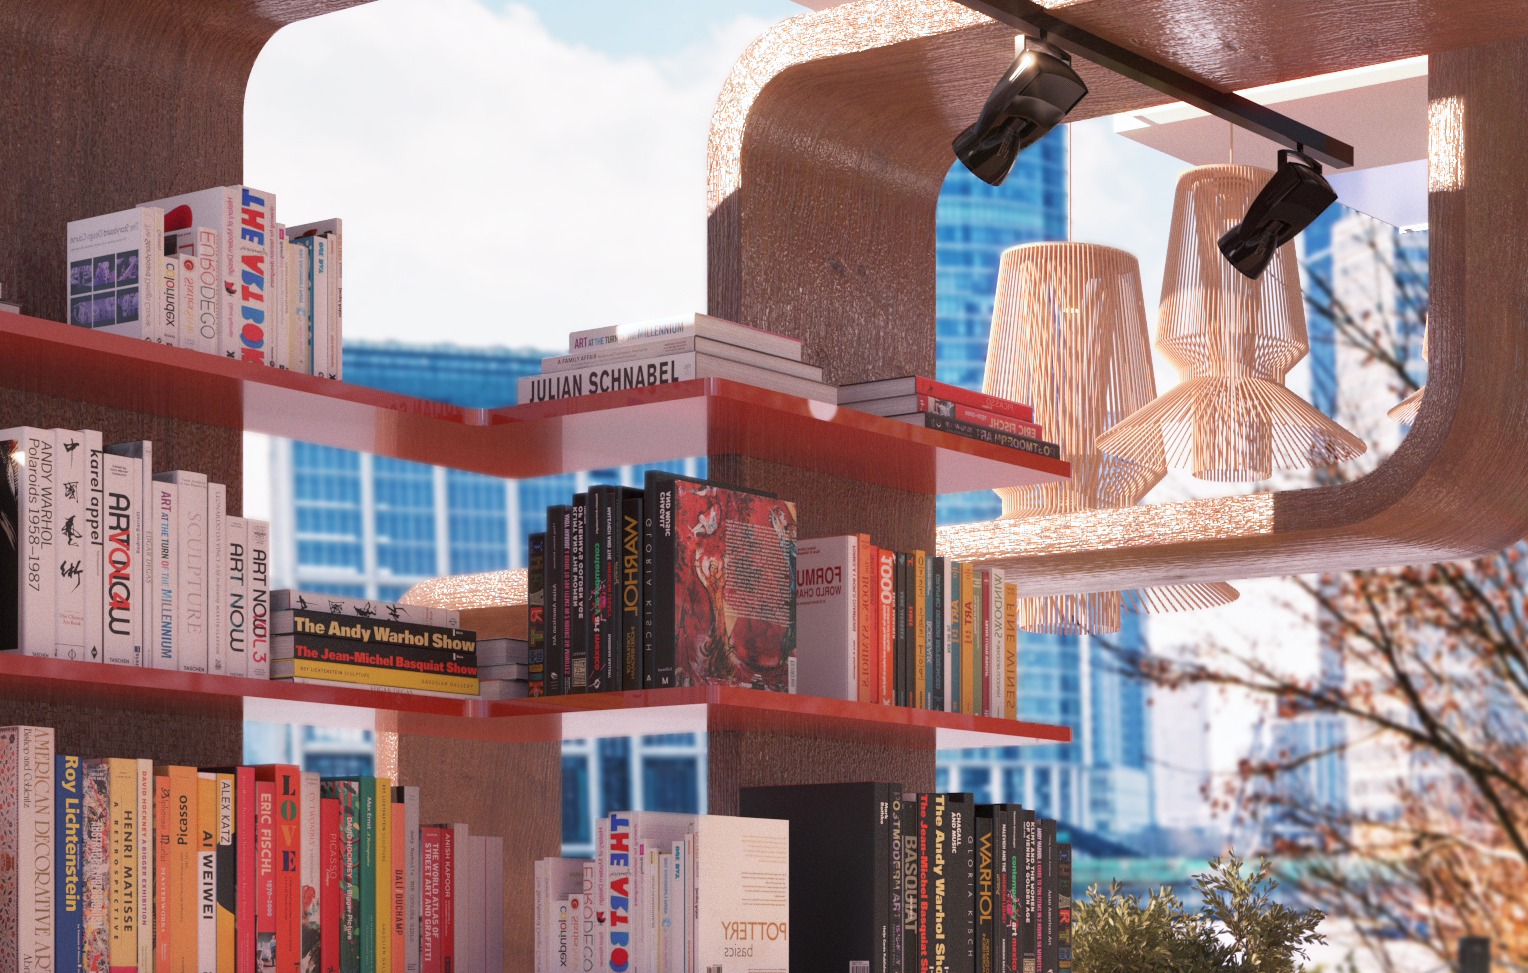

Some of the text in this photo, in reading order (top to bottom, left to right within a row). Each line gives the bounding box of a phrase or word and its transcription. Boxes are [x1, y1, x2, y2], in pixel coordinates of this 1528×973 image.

[529, 360, 679, 403] JULIAN SCHNABEL
[28, 438, 40, 503] Polaroids
[40, 440, 53, 550] ANDY WARHOL
[86, 449, 103, 545] karel appel
[160, 491, 173, 659] ART AT THE TURN OF THE MILLENNIUM
[187, 512, 202, 634] SCULPTURE
[230, 543, 244, 652] ART NOW
[253, 549, 267, 587] ART
[294, 616, 475, 652] The Andy Warhol Show
[295, 644, 477, 676] The Jean-Michel Basquiat Show
[34, 729, 51, 814] AMERICAN
[62, 755, 80, 911] Roy Lichtenstein
[177, 795, 188, 845] Picasso
[221, 781, 231, 843] ALEX KATZ
[261, 793, 272, 876] ERIC FISCHL
[346, 816, 354, 838] DAVID
[935, 794, 946, 826] The
[34, 819, 51, 936] DECORATIVE
[123, 810, 133, 932] HENRI MATISSE
[203, 830, 213, 920] AI WEIWEI
[329, 833, 338, 880] PICASSO
[346, 841, 354, 877] HOCKNEY
[933, 830, 945, 875] Andy
[979, 832, 992, 925] WARHOL
[346, 889, 354, 912] Bigger
[905, 835, 917, 934] BASQUIAT
[935, 878, 946, 939] Warhol
[346, 914, 354, 940] Picture
[432, 926, 439, 939] OF
